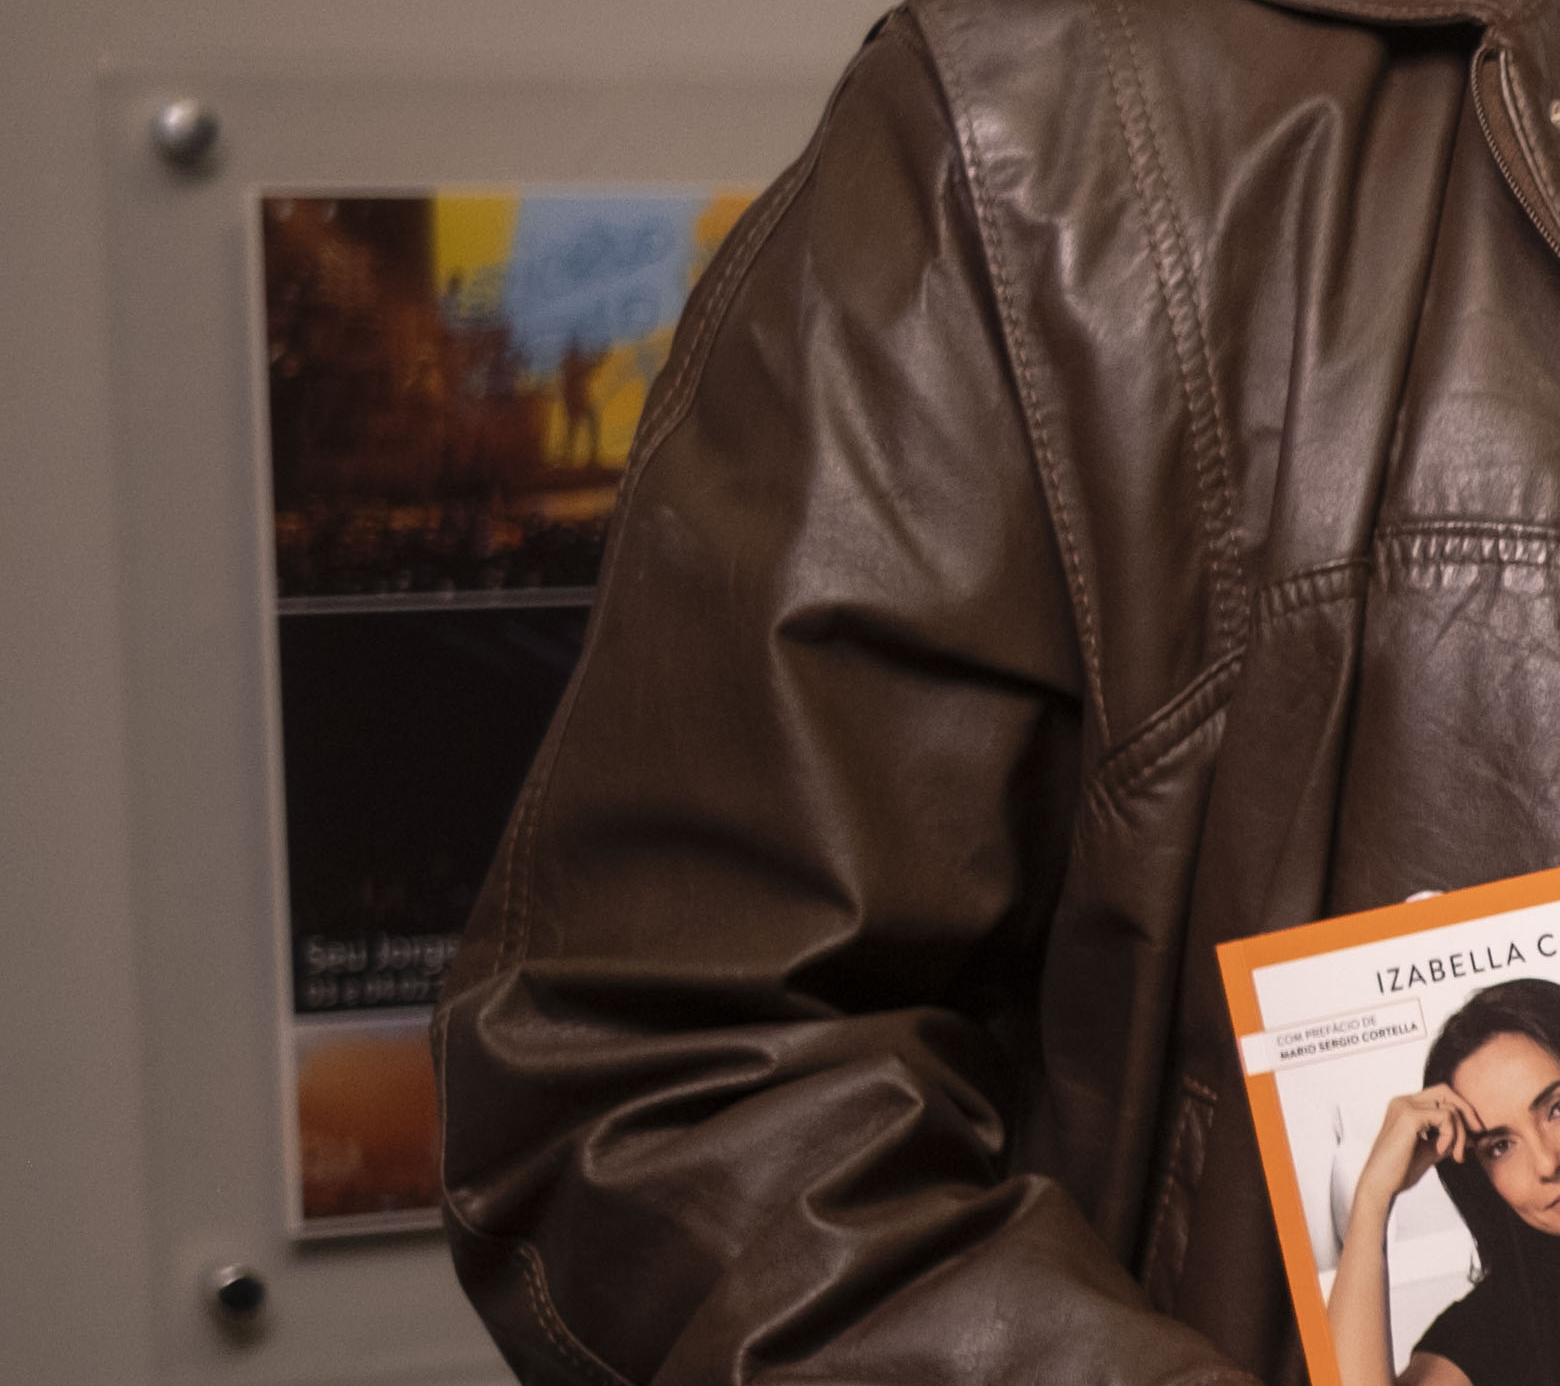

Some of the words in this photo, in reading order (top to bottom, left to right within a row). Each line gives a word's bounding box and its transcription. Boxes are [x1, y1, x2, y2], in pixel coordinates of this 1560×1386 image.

[1375, 942, 1526, 996] IZABELLA
[1276, 1034, 1303, 1047] COM
[1362, 1014, 1377, 1027] DE
[1280, 1045, 1317, 1060] MARIO
[1362, 1021, 1418, 1044] CORTELLA
